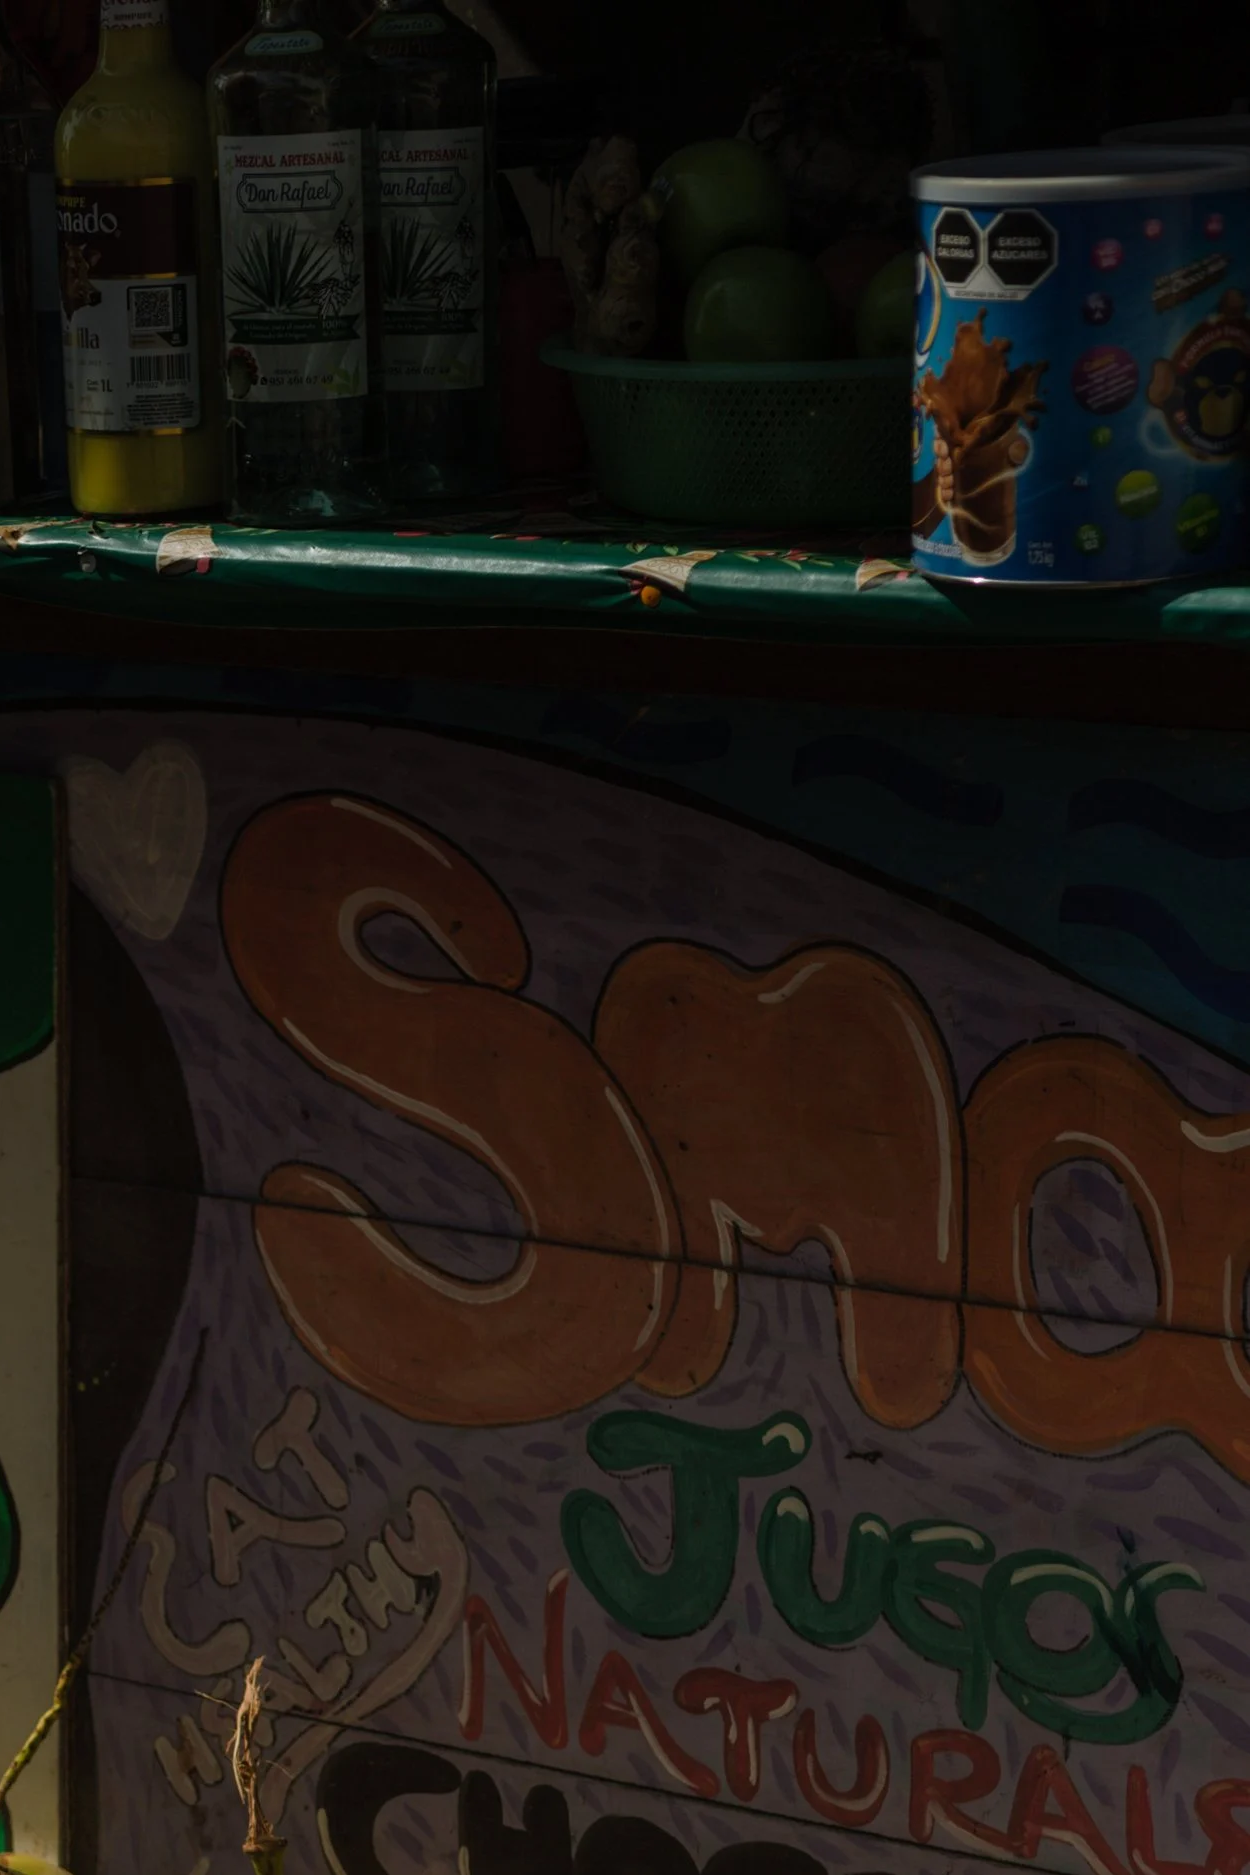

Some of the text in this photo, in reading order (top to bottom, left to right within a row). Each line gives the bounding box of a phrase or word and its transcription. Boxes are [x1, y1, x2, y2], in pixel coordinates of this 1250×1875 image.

[235, 150, 346, 169] MEZCAL ARTESANAL
[405, 147, 470, 163] ARTESANAL
[244, 179, 331, 209] Don Rafael
[405, 176, 454, 204] Rafael
